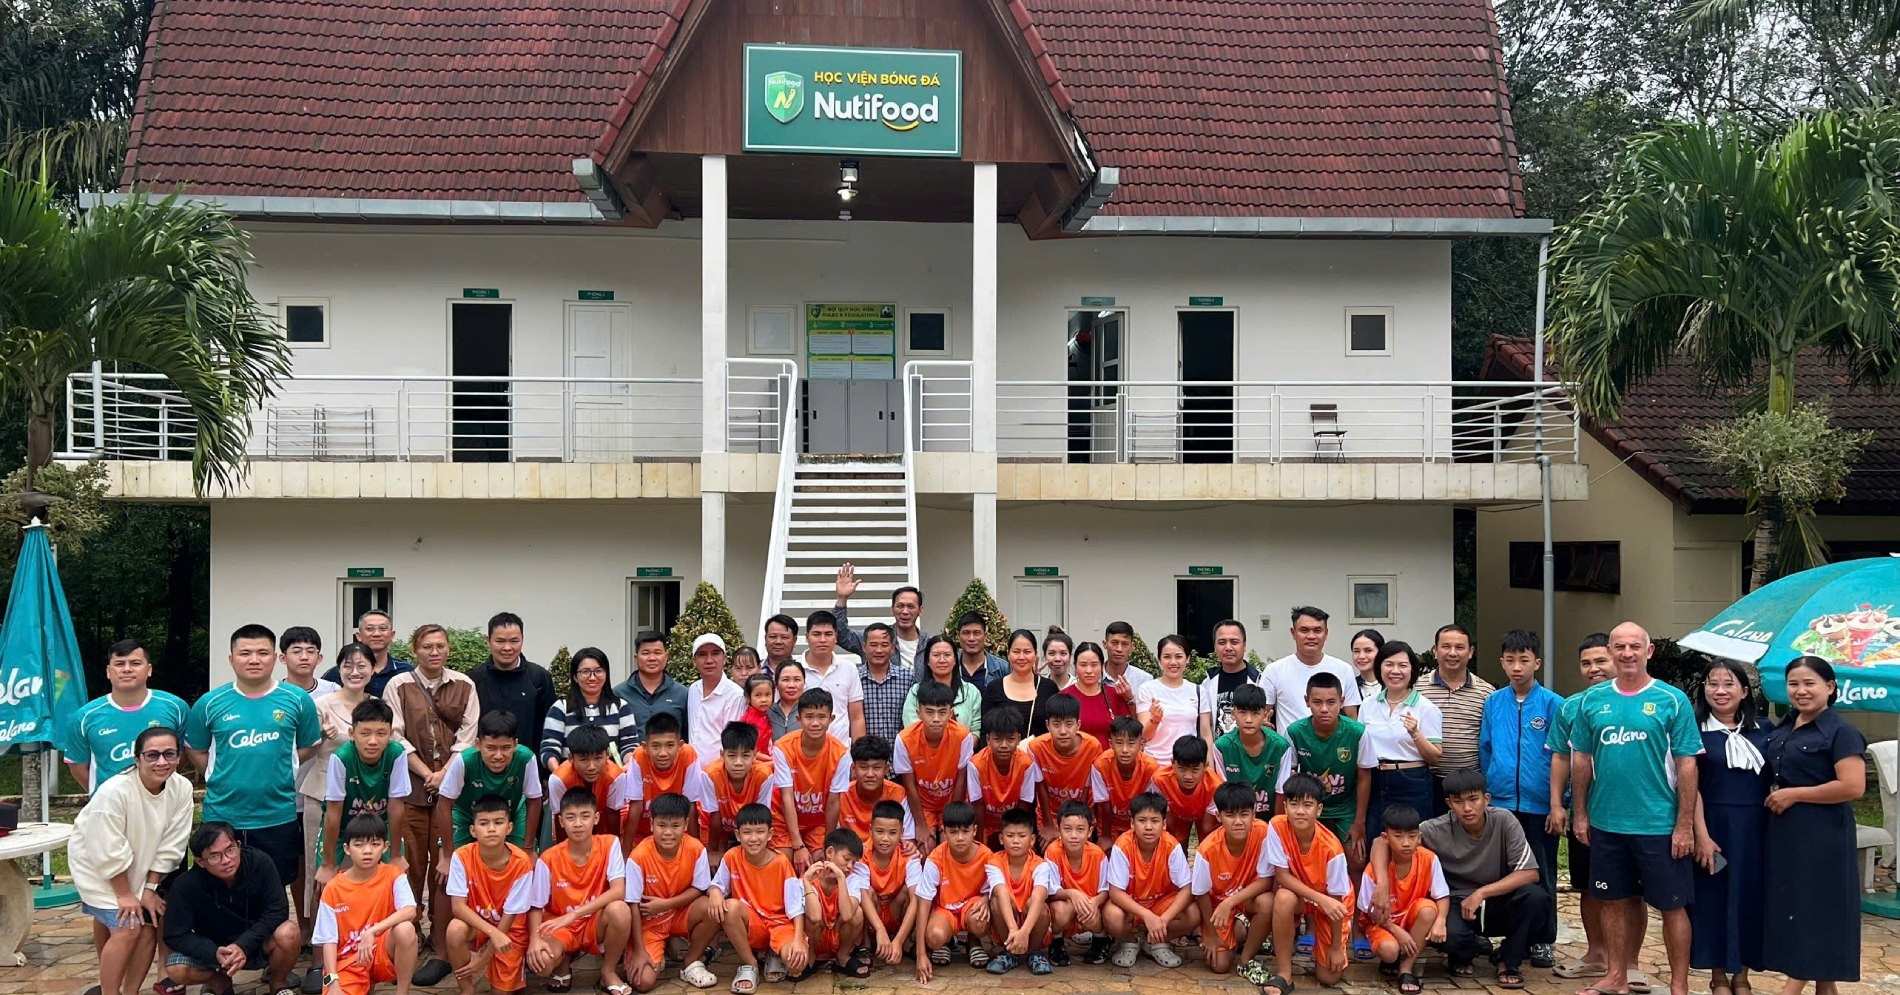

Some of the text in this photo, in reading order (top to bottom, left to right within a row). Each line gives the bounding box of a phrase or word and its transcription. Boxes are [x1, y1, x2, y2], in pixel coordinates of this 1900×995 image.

[814, 71, 941, 87] HỌC VIỆN BÓNG ĐÁ
[814, 91, 939, 123] Nutifood
[228, 729, 280, 748] Celano
[1600, 726, 1648, 745] Celano
[110, 741, 136, 761] Cel
[1595, 880, 1608, 890] GG
